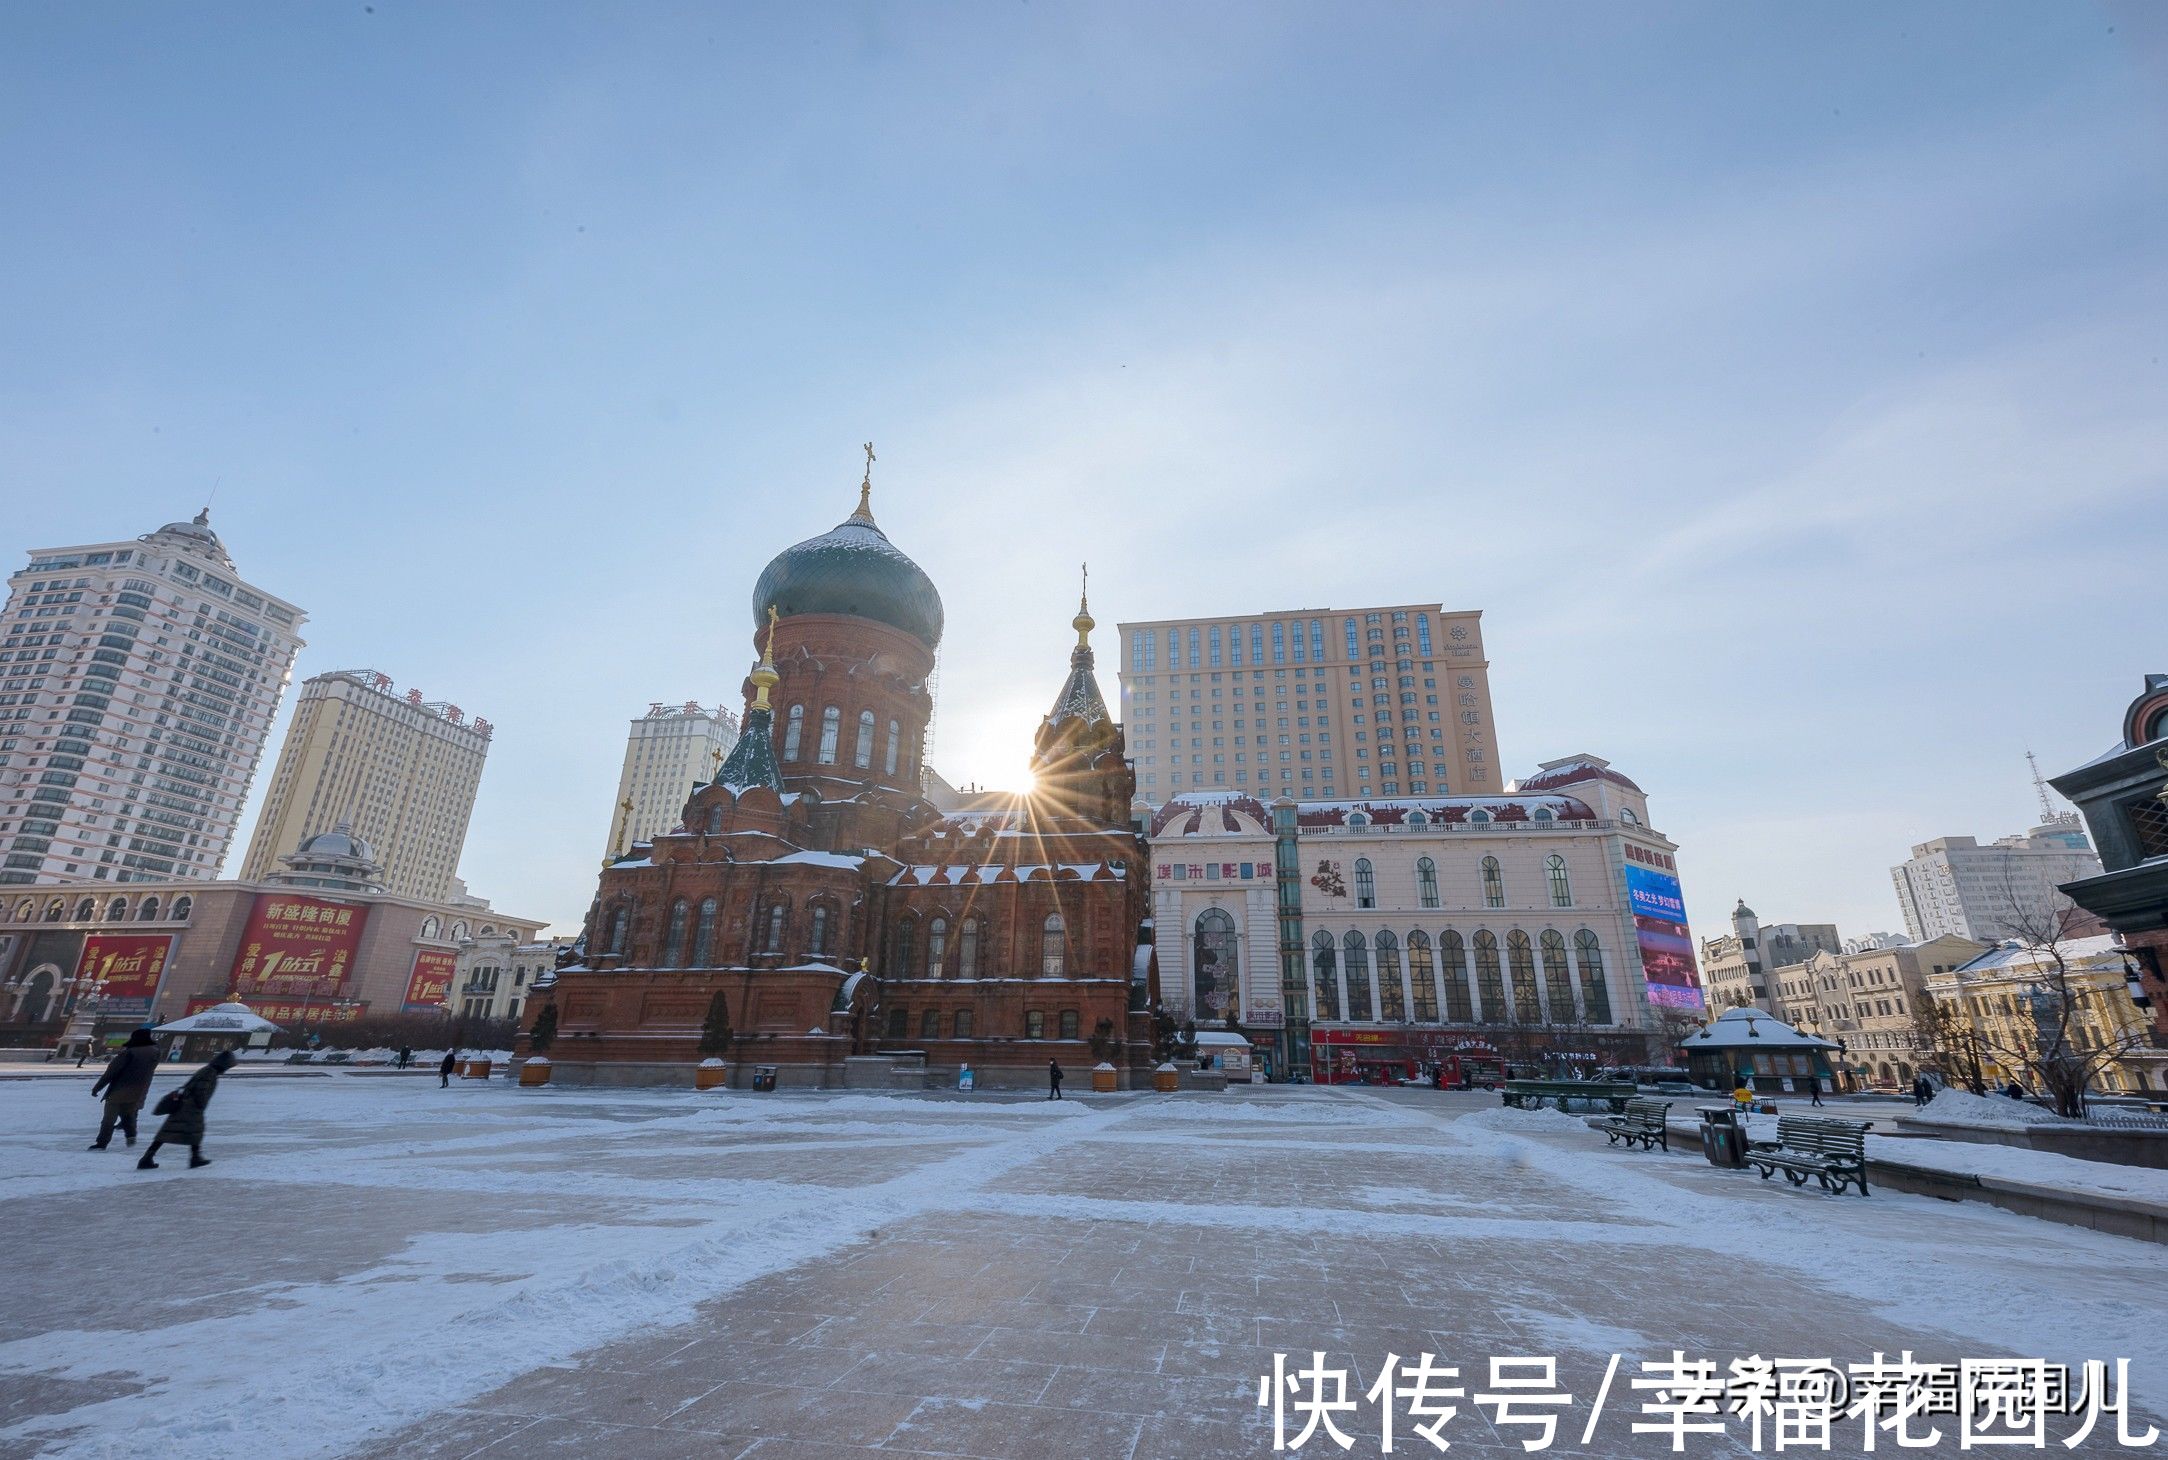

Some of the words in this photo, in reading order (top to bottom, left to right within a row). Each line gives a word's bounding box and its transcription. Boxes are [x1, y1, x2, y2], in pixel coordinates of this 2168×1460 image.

[1458, 676, 1486, 782] 曼哈顿大酒店
[265, 902, 353, 927] 新盛隆商厦
